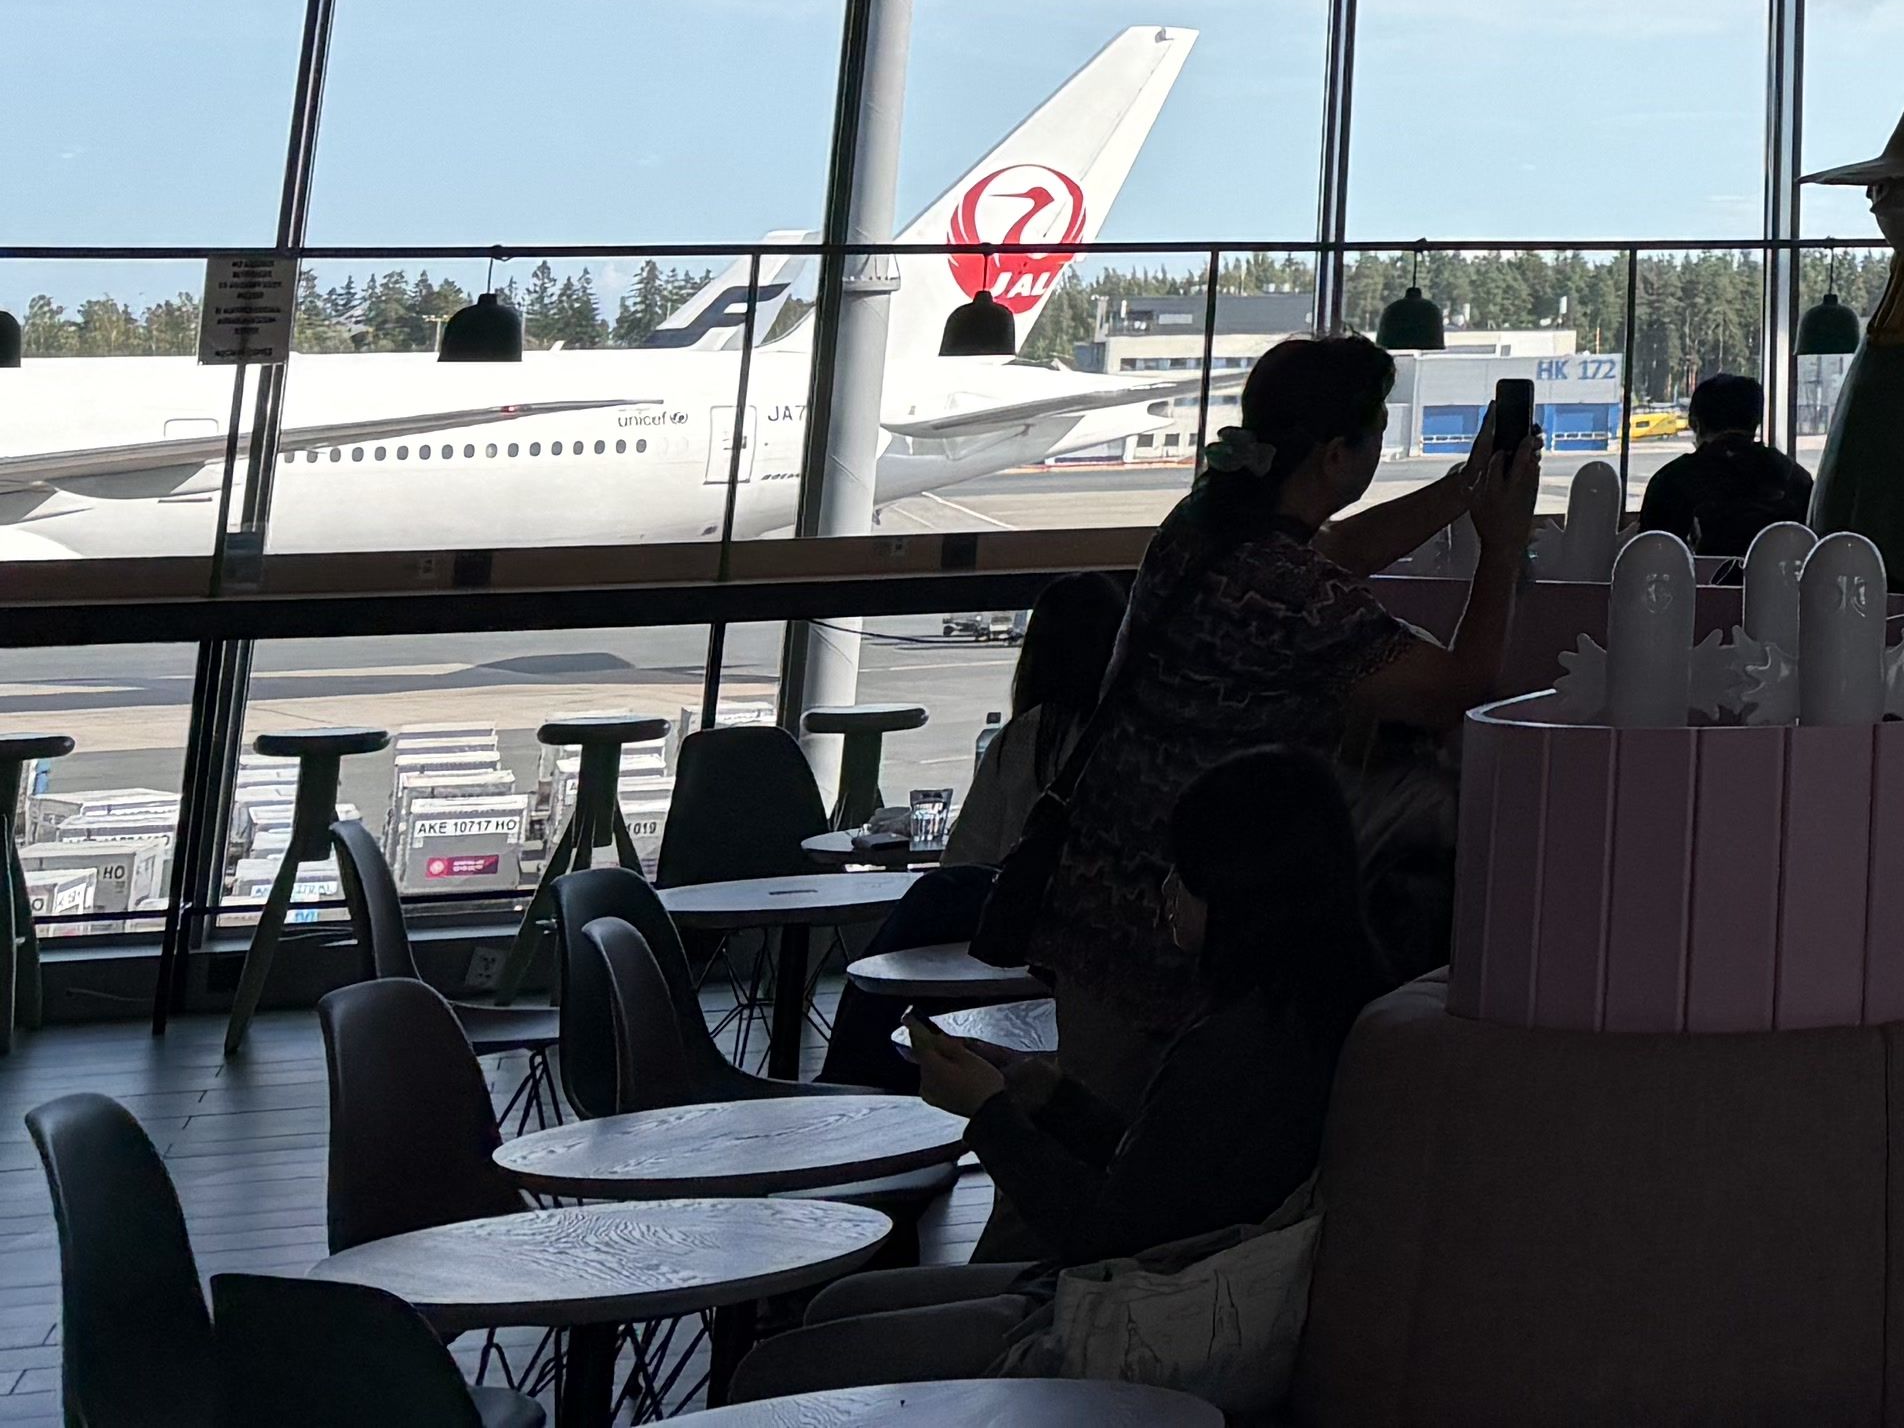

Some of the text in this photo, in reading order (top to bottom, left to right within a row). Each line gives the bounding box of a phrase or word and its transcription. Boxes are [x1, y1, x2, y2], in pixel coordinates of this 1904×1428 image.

[990, 271, 1052, 298] JAL
[1536, 359, 1616, 380] HK 172
[417, 818, 517, 835] AKE 10717 HO
[103, 864, 126, 880] HO
